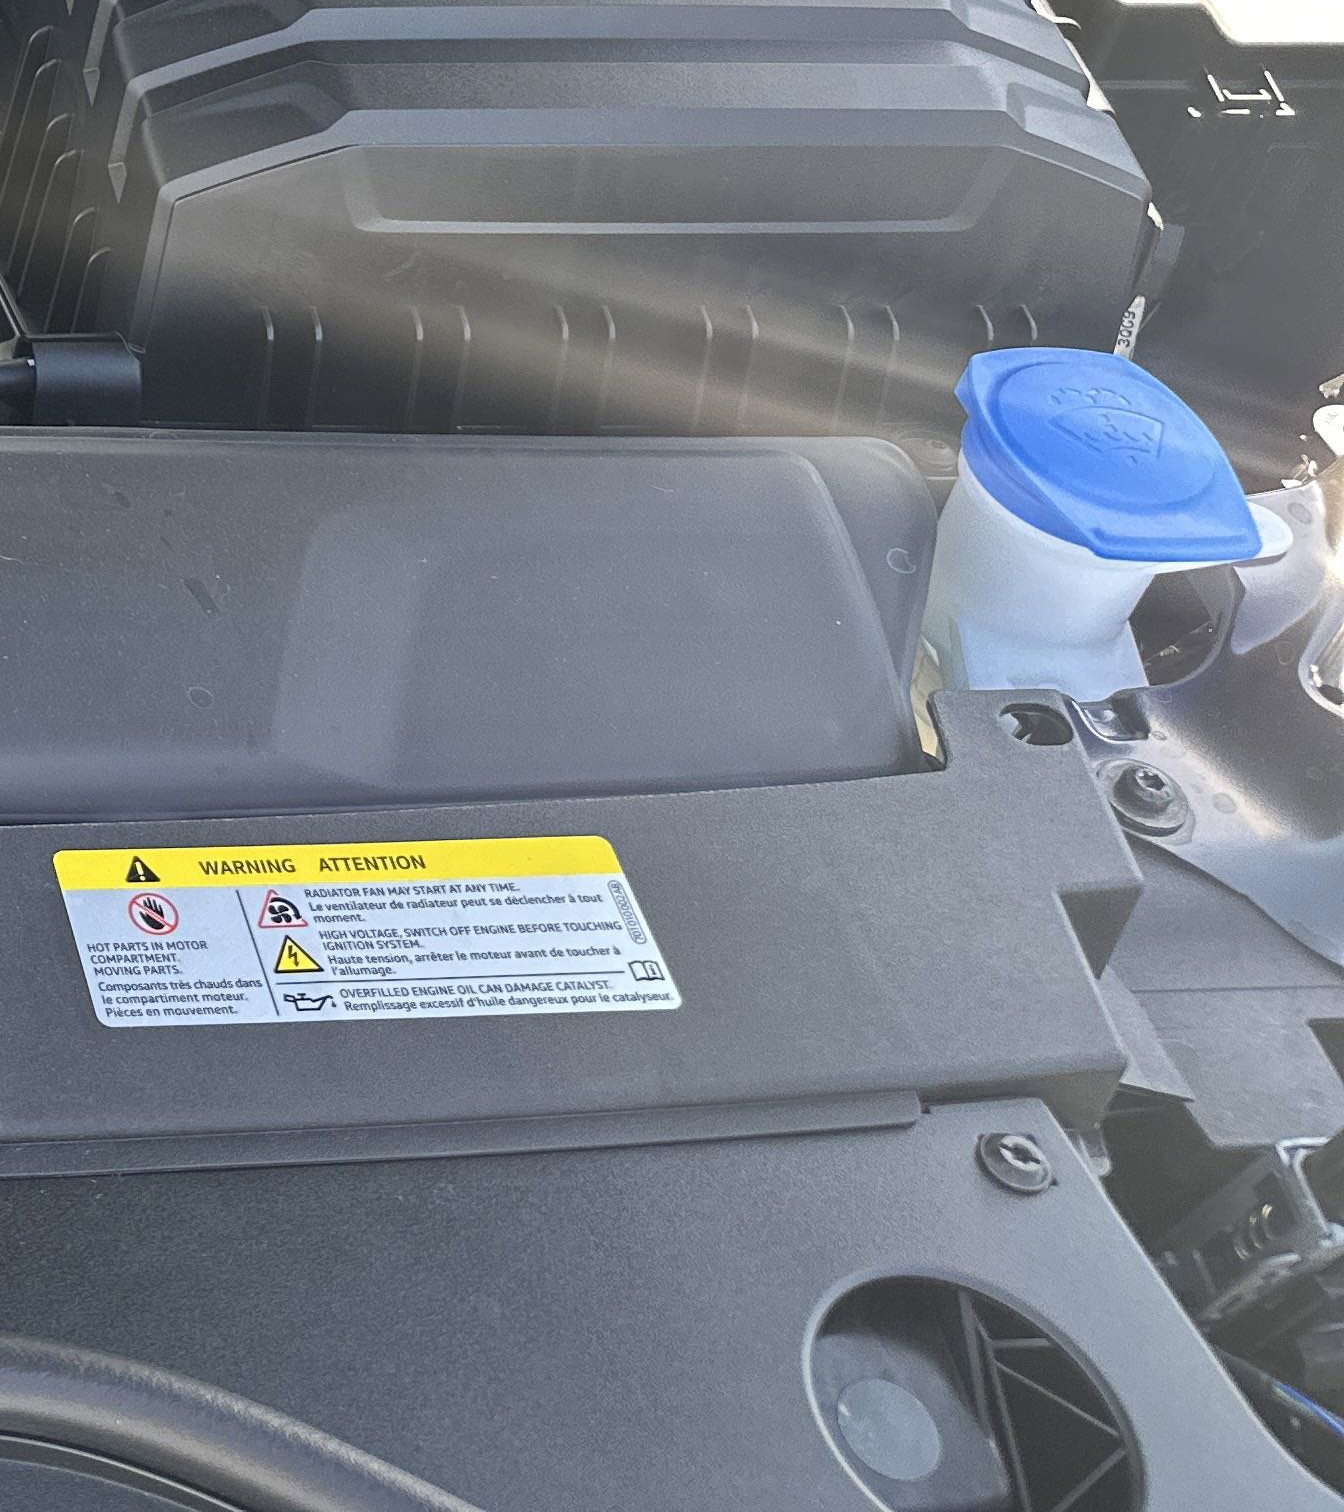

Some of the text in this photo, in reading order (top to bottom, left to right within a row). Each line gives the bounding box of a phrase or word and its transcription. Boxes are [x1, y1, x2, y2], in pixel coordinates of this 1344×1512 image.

[199, 859, 296, 875] WARNING
[319, 856, 426, 872] ATTENTION
[304, 888, 360, 898] RADIATOR
[363, 887, 385, 896] FAN
[388, 887, 410, 895] MAY
[415, 885, 446, 894] START
[450, 885, 464, 893] AT
[465, 883, 486, 892] ANY
[309, 902, 323, 911] Le
[326, 901, 387, 911] ventilateur
[390, 900, 403, 909] de
[407, 899, 457, 908] radiateur
[461, 898, 487, 909] peut
[505, 895, 565, 905] déclencher
[569, 894, 576, 903] à
[579, 894, 602, 902] tout
[313, 914, 366, 923] moment.
[319, 931, 347, 939] HIGH
[405, 927, 448, 937] SWITCH
[449, 926, 471, 935] OFF
[474, 924, 516, 935] ENGINE
[518, 923, 561, 933] BEFORE
[563, 921, 622, 932] TOUCHING
[87, 941, 208, 952] HOT PARTS IN MOTOR
[323, 940, 374, 951] IGNITION
[328, 946, 621, 964] Haute tension, arrêter le moteur avant de toucher à
[94, 965, 141, 976] MOVING
[98, 979, 262, 993] Composants très chauds dans
[340, 988, 409, 998] OVERFILLED
[412, 986, 454, 996] ENGINE
[457, 985, 475, 994] OIL
[479, 984, 502, 993] CAN
[505, 983, 554, 992] DAMAGE
[102, 993, 248, 1005] le compartiment moteur.
[105, 1005, 237, 1017] Pièces en mouvement.
